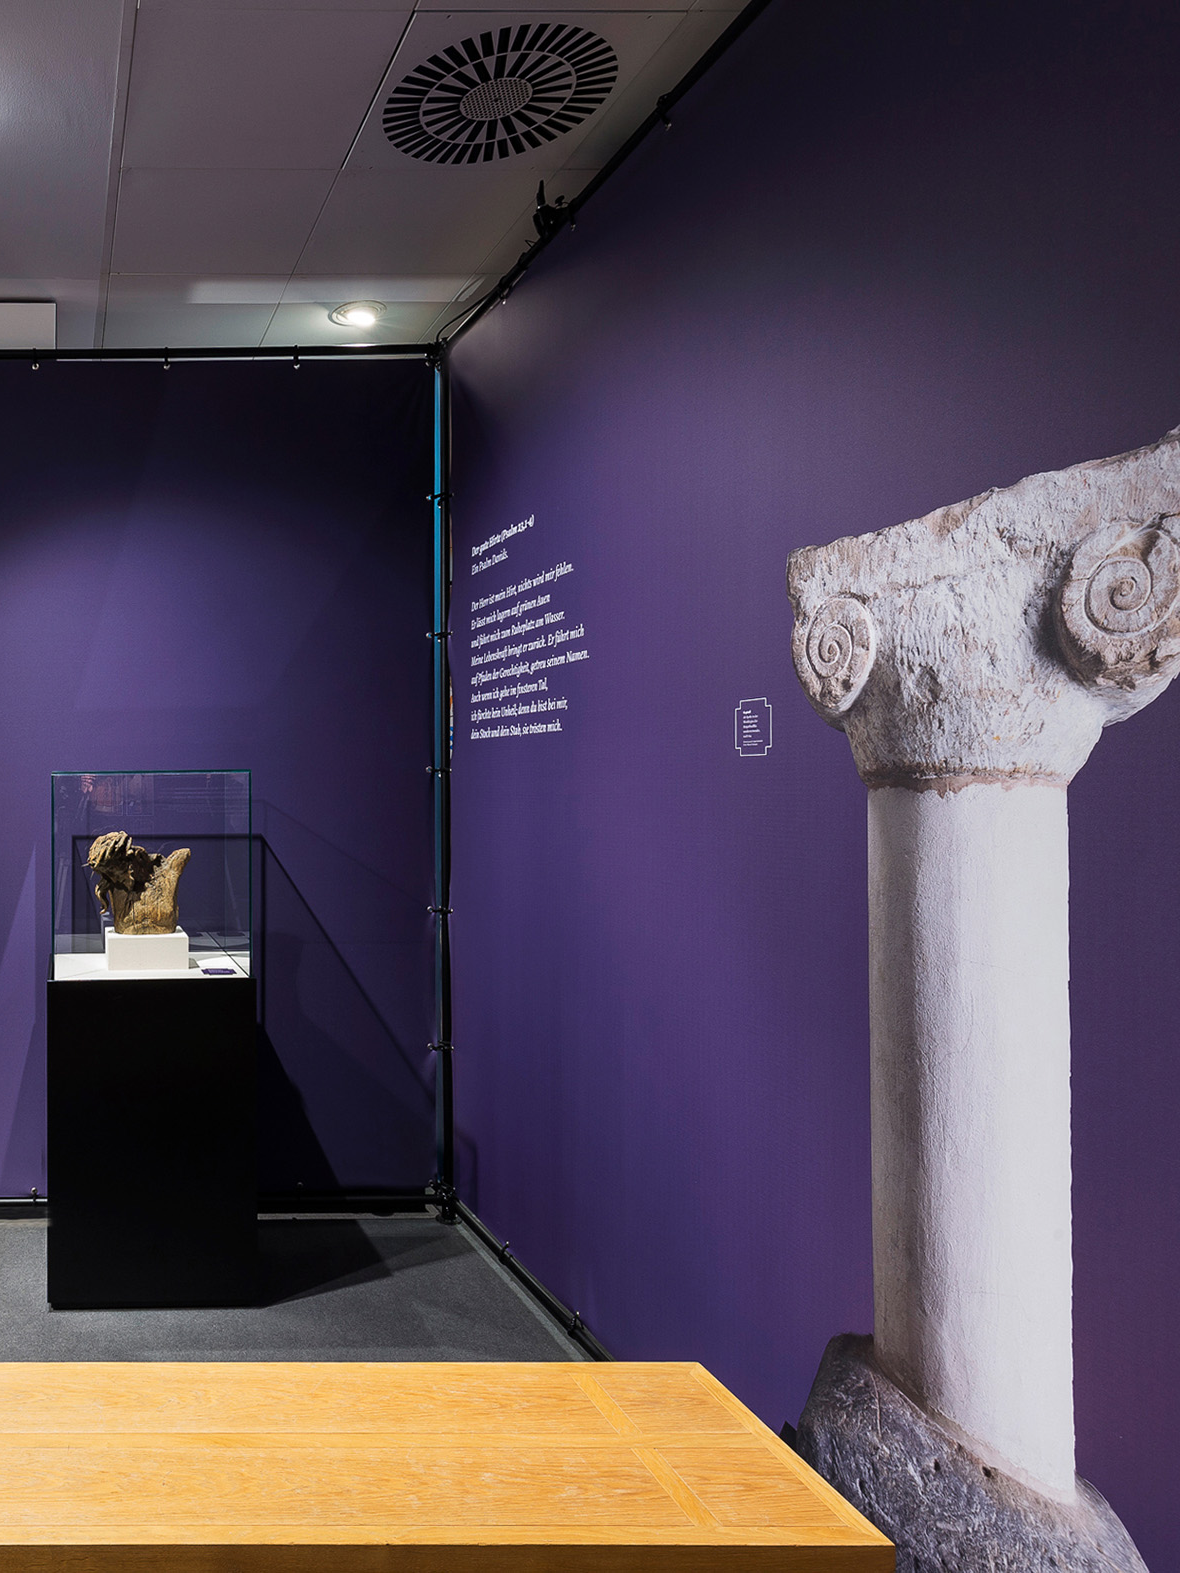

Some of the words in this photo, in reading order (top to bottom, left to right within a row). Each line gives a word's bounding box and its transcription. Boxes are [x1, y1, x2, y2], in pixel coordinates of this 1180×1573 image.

[471, 546, 480, 557] Der
[479, 540, 489, 556] gute
[501, 524, 517, 542] (Psalm
[471, 563, 479, 575] Ein
[479, 557, 492, 572] Psalm
[471, 601, 479, 612] Der
[479, 598, 489, 609] Herr
[495, 589, 506, 602] mein
[506, 585, 517, 598] Hirt,
[518, 578, 533, 593] nichts
[533, 570, 544, 587] wird
[545, 568, 555, 582] mir
[554, 561, 574, 582] fehlen.
[471, 620, 477, 630] Er
[476, 616, 486, 628] lässt
[486, 611, 496, 624] mich
[496, 609, 511, 623] lagern
[511, 601, 521, 617] auf
[519, 600, 537, 616] grünen
[537, 594, 550, 607] Auen
[471, 635, 479, 648] und
[478, 633, 490, 649] führt
[490, 628, 500, 642] mich
[501, 629, 511, 639] zum
[511, 619, 535, 635] Ruheplatz
[535, 618, 544, 628] am
[544, 611, 565, 625] Wasser.
[471, 655, 483, 667] Meine
[484, 646, 508, 661] Lebenskraft
[508, 643, 523, 658] bringt
[522, 644, 528, 653] er
[528, 635, 547, 651] zurück.
[548, 633, 555, 646] Er
[554, 629, 569, 648] führt
[570, 623, 585, 640] mich
[471, 672, 479, 687] auf
[478, 670, 492, 686] Pfaden
[500, 661, 530, 678] Gerechtigkeit,
[530, 659, 546, 675] getreu
[547, 654, 565, 668] seinem
[566, 650, 590, 663] Namen.
[470, 691, 481, 703] Auch
[481, 692, 492, 701] wenn
[499, 685, 510, 701] gehe
[510, 684, 517, 696] im
[516, 682, 538, 698] finsteren
[538, 677, 548, 691] Tal,
[491, 707, 501, 718] kein
[518, 702, 530, 715] denn
[530, 700, 537, 713] du
[537, 699, 547, 712] bist
[548, 697, 556, 711] bei
[556, 696, 568, 710] mir,
[471, 729, 479, 740] dein
[479, 726, 491, 739] Stock
[491, 725, 500, 737] und
[500, 725, 509, 737] dein
[510, 723, 522, 737] Stab,
[529, 722, 547, 734] trösten
[547, 718, 563, 732] mich.
